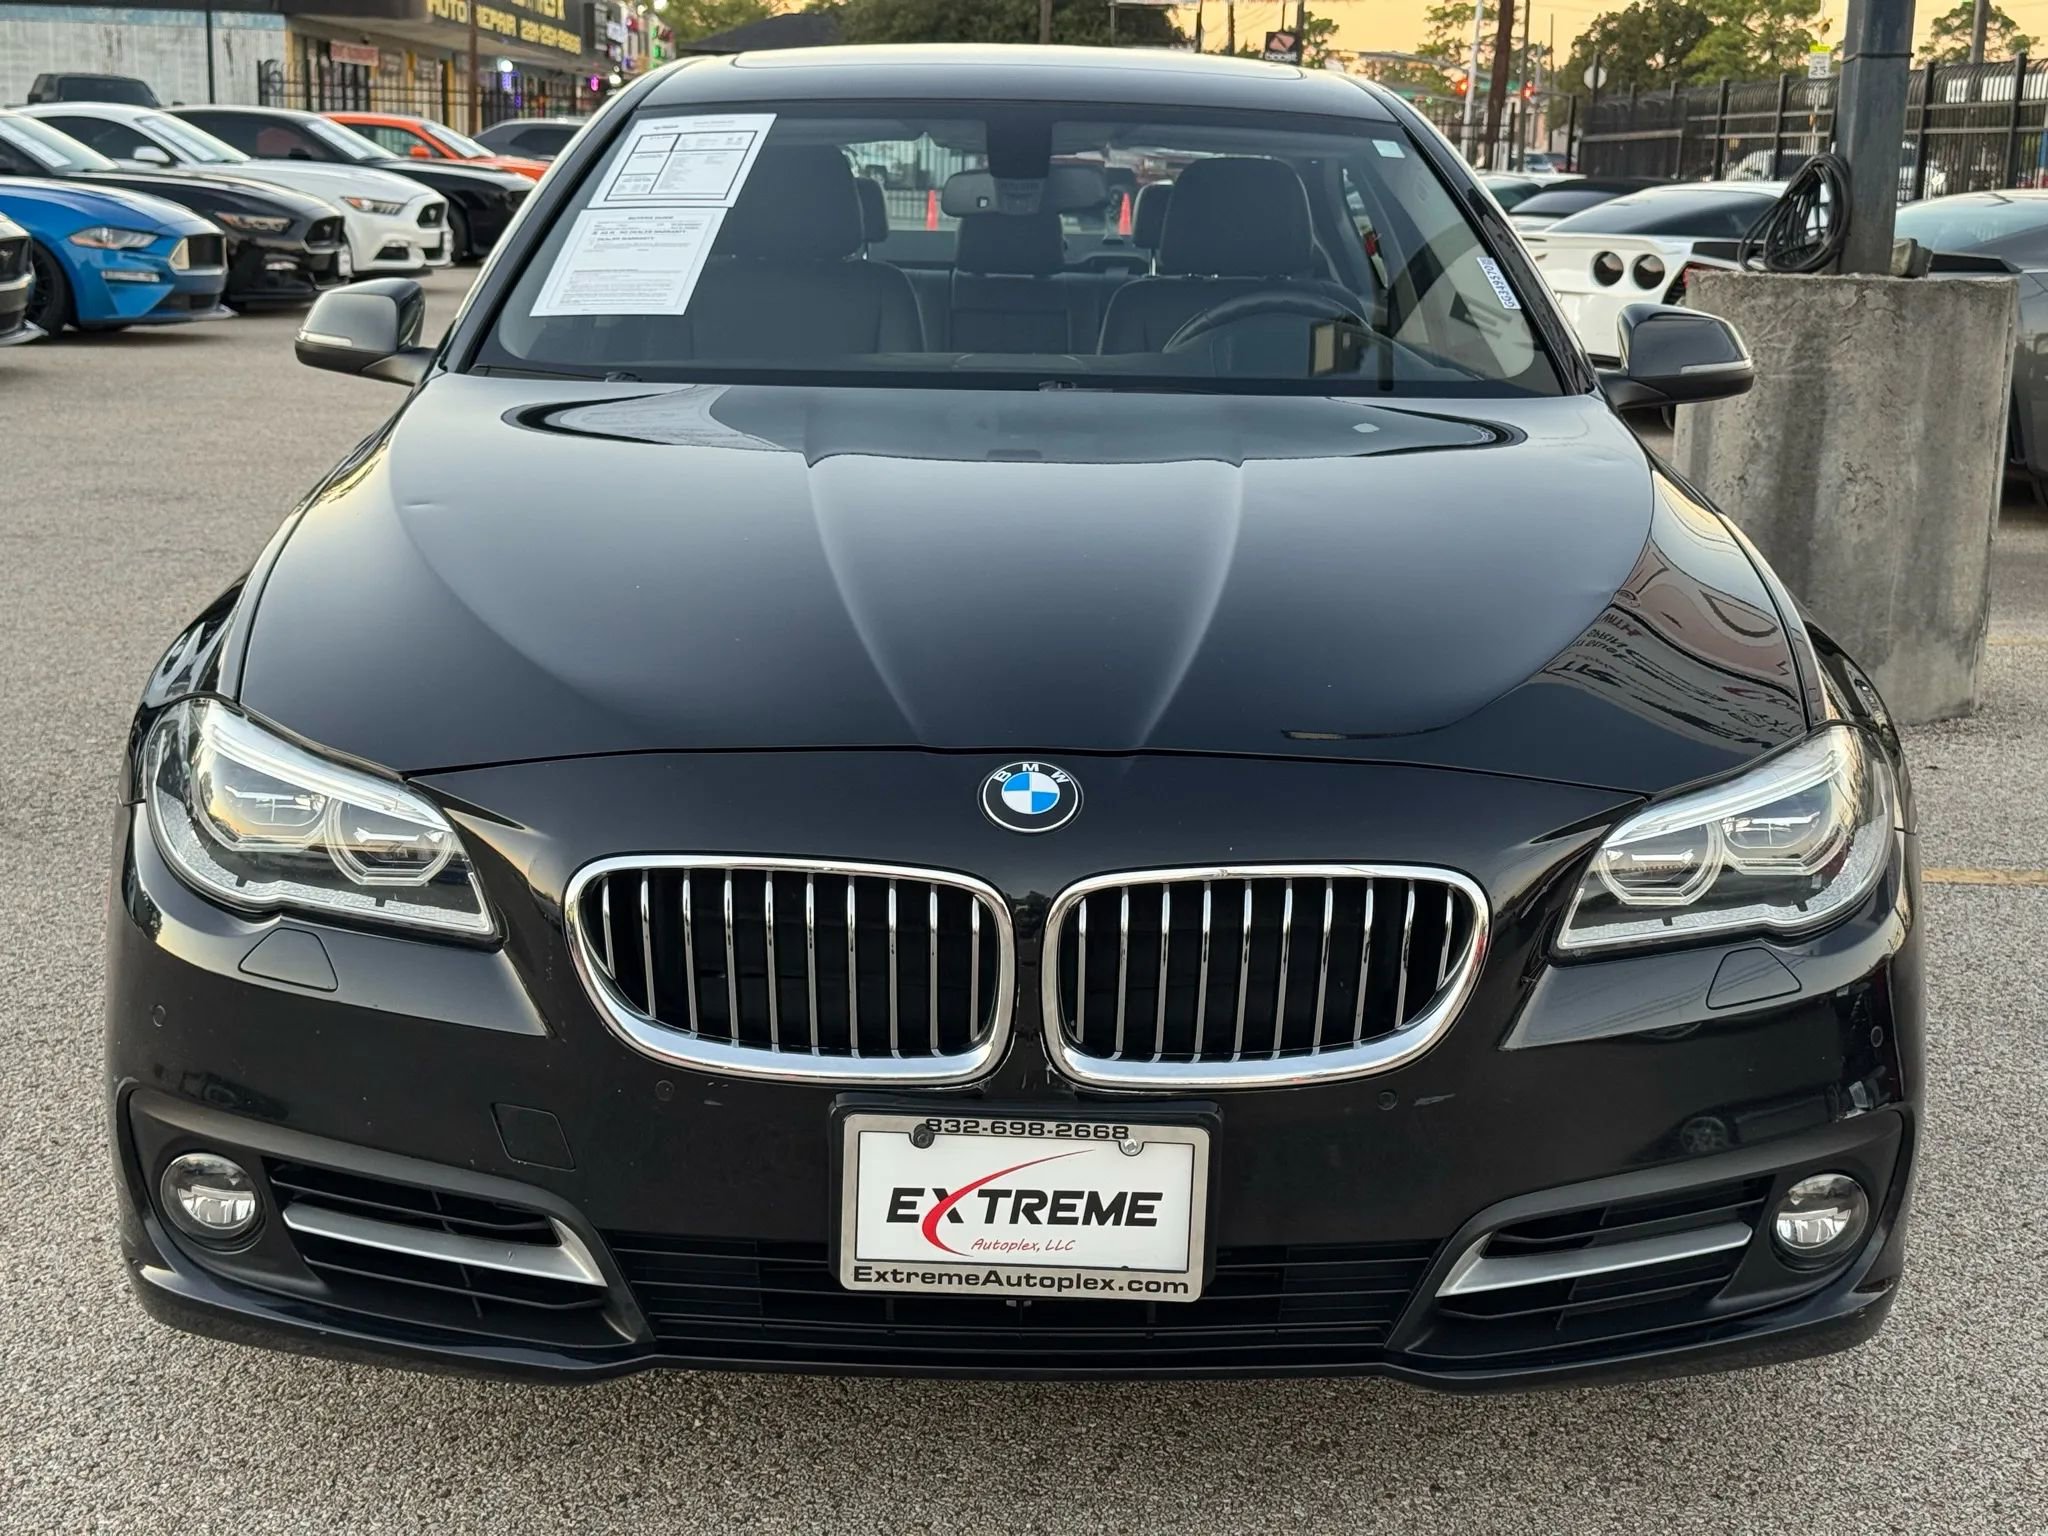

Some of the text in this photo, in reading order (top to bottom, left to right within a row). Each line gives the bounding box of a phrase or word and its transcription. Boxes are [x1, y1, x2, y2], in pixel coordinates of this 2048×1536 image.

[992, 763, 1070, 784] BMW
[925, 1118, 1129, 1140] 832-698-2668
[886, 1186, 1164, 1227] EXTREME
[970, 1238, 1077, 1253] Autoplex, LLC
[853, 1265, 1189, 1295] ExtremeAutoplex.com
